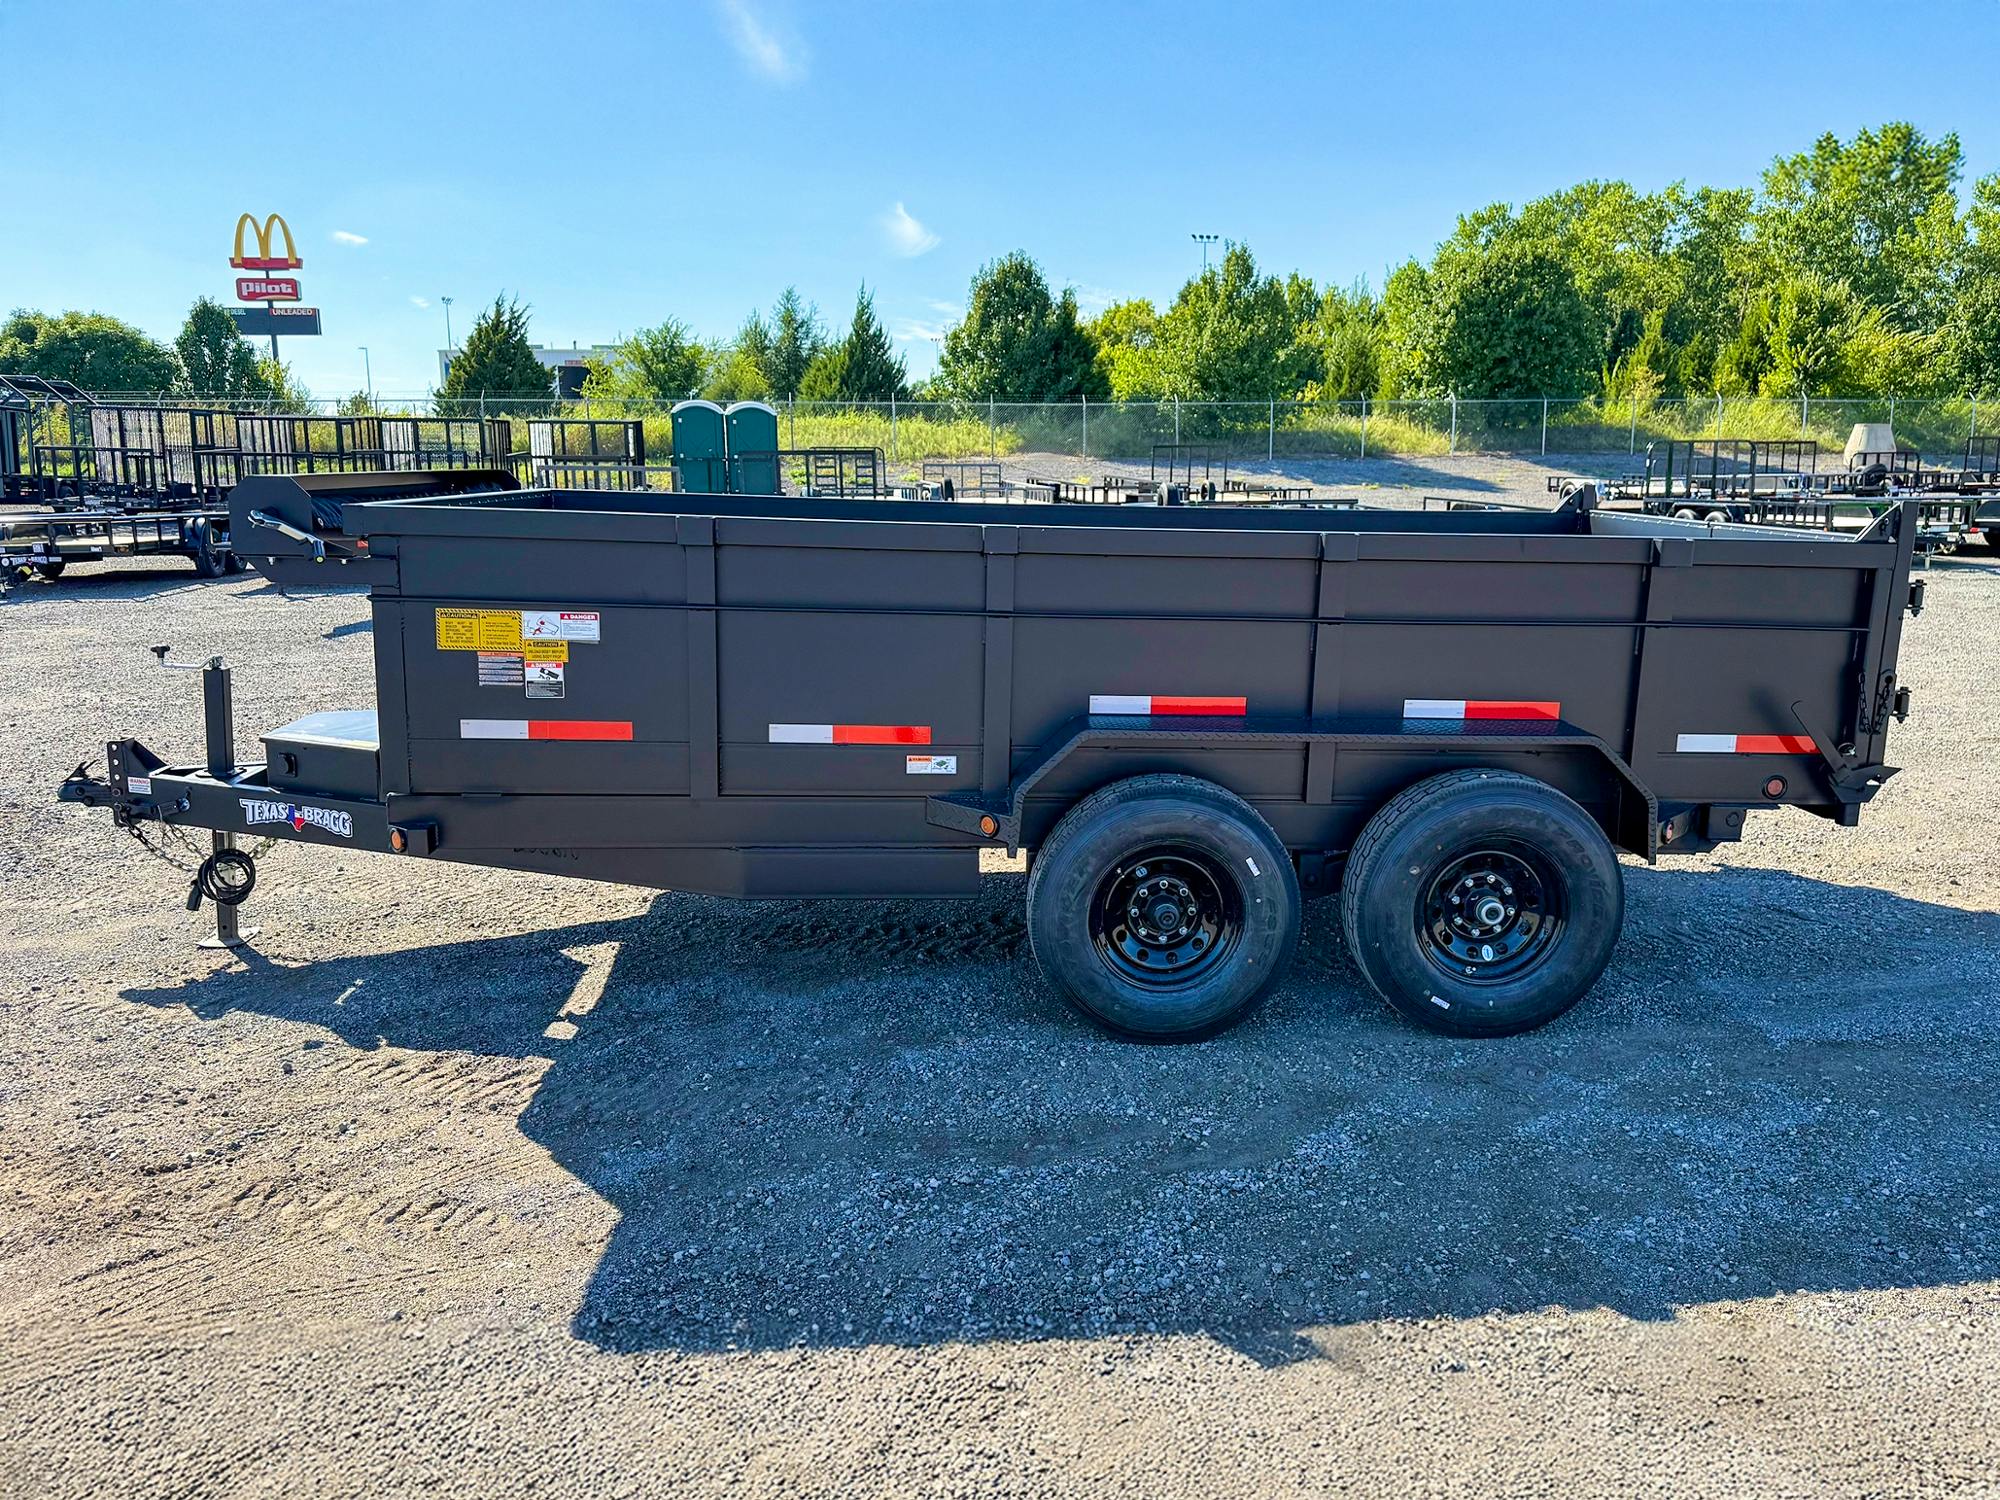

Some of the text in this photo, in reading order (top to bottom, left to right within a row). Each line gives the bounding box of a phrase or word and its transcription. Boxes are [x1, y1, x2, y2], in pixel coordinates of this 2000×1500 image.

[241, 282, 293, 296] Pilot
[272, 308, 313, 316] UNLEADED
[240, 799, 352, 837] TEXAS BRAGG
